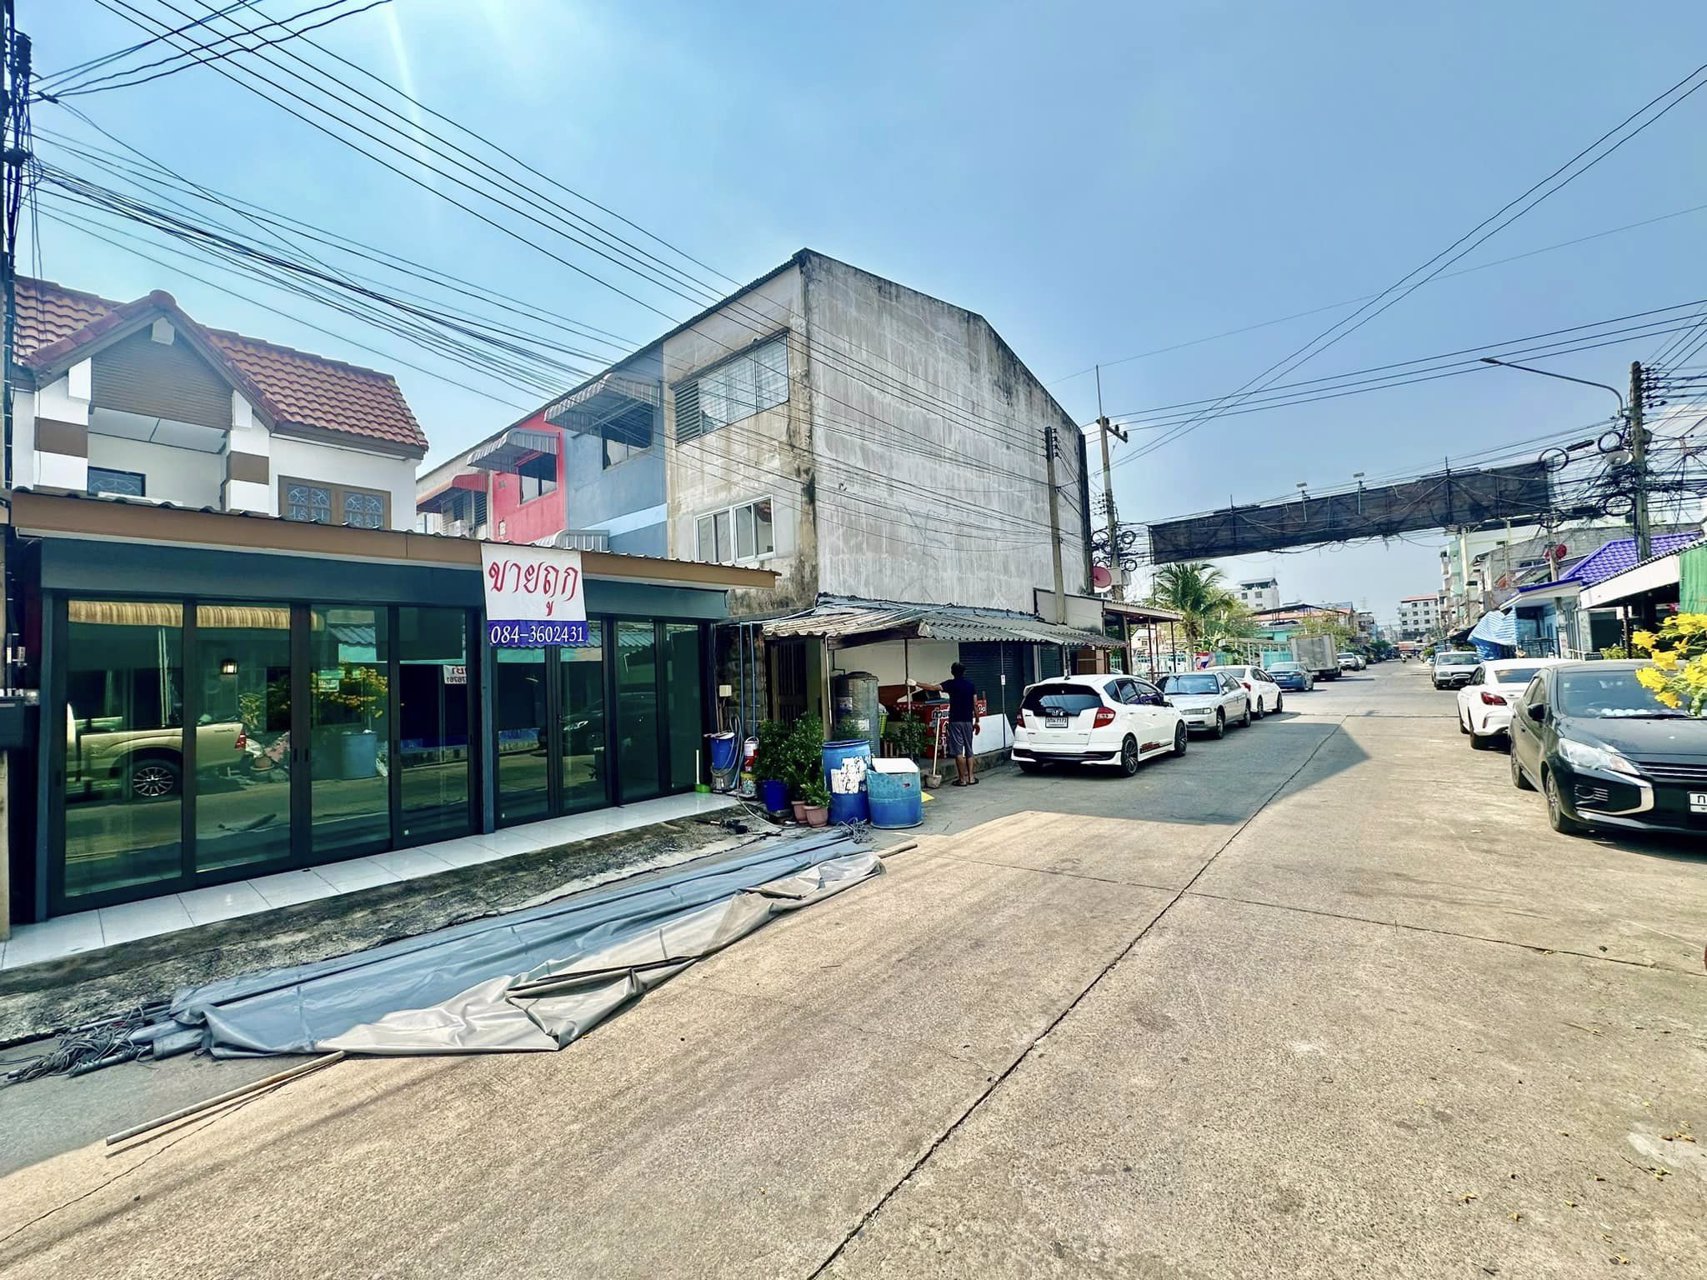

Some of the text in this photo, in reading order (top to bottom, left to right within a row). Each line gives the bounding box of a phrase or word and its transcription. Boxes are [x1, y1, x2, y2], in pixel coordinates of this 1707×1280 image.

[488, 560, 579, 617] ขายถูก
[490, 625, 585, 644] 084-3602431
